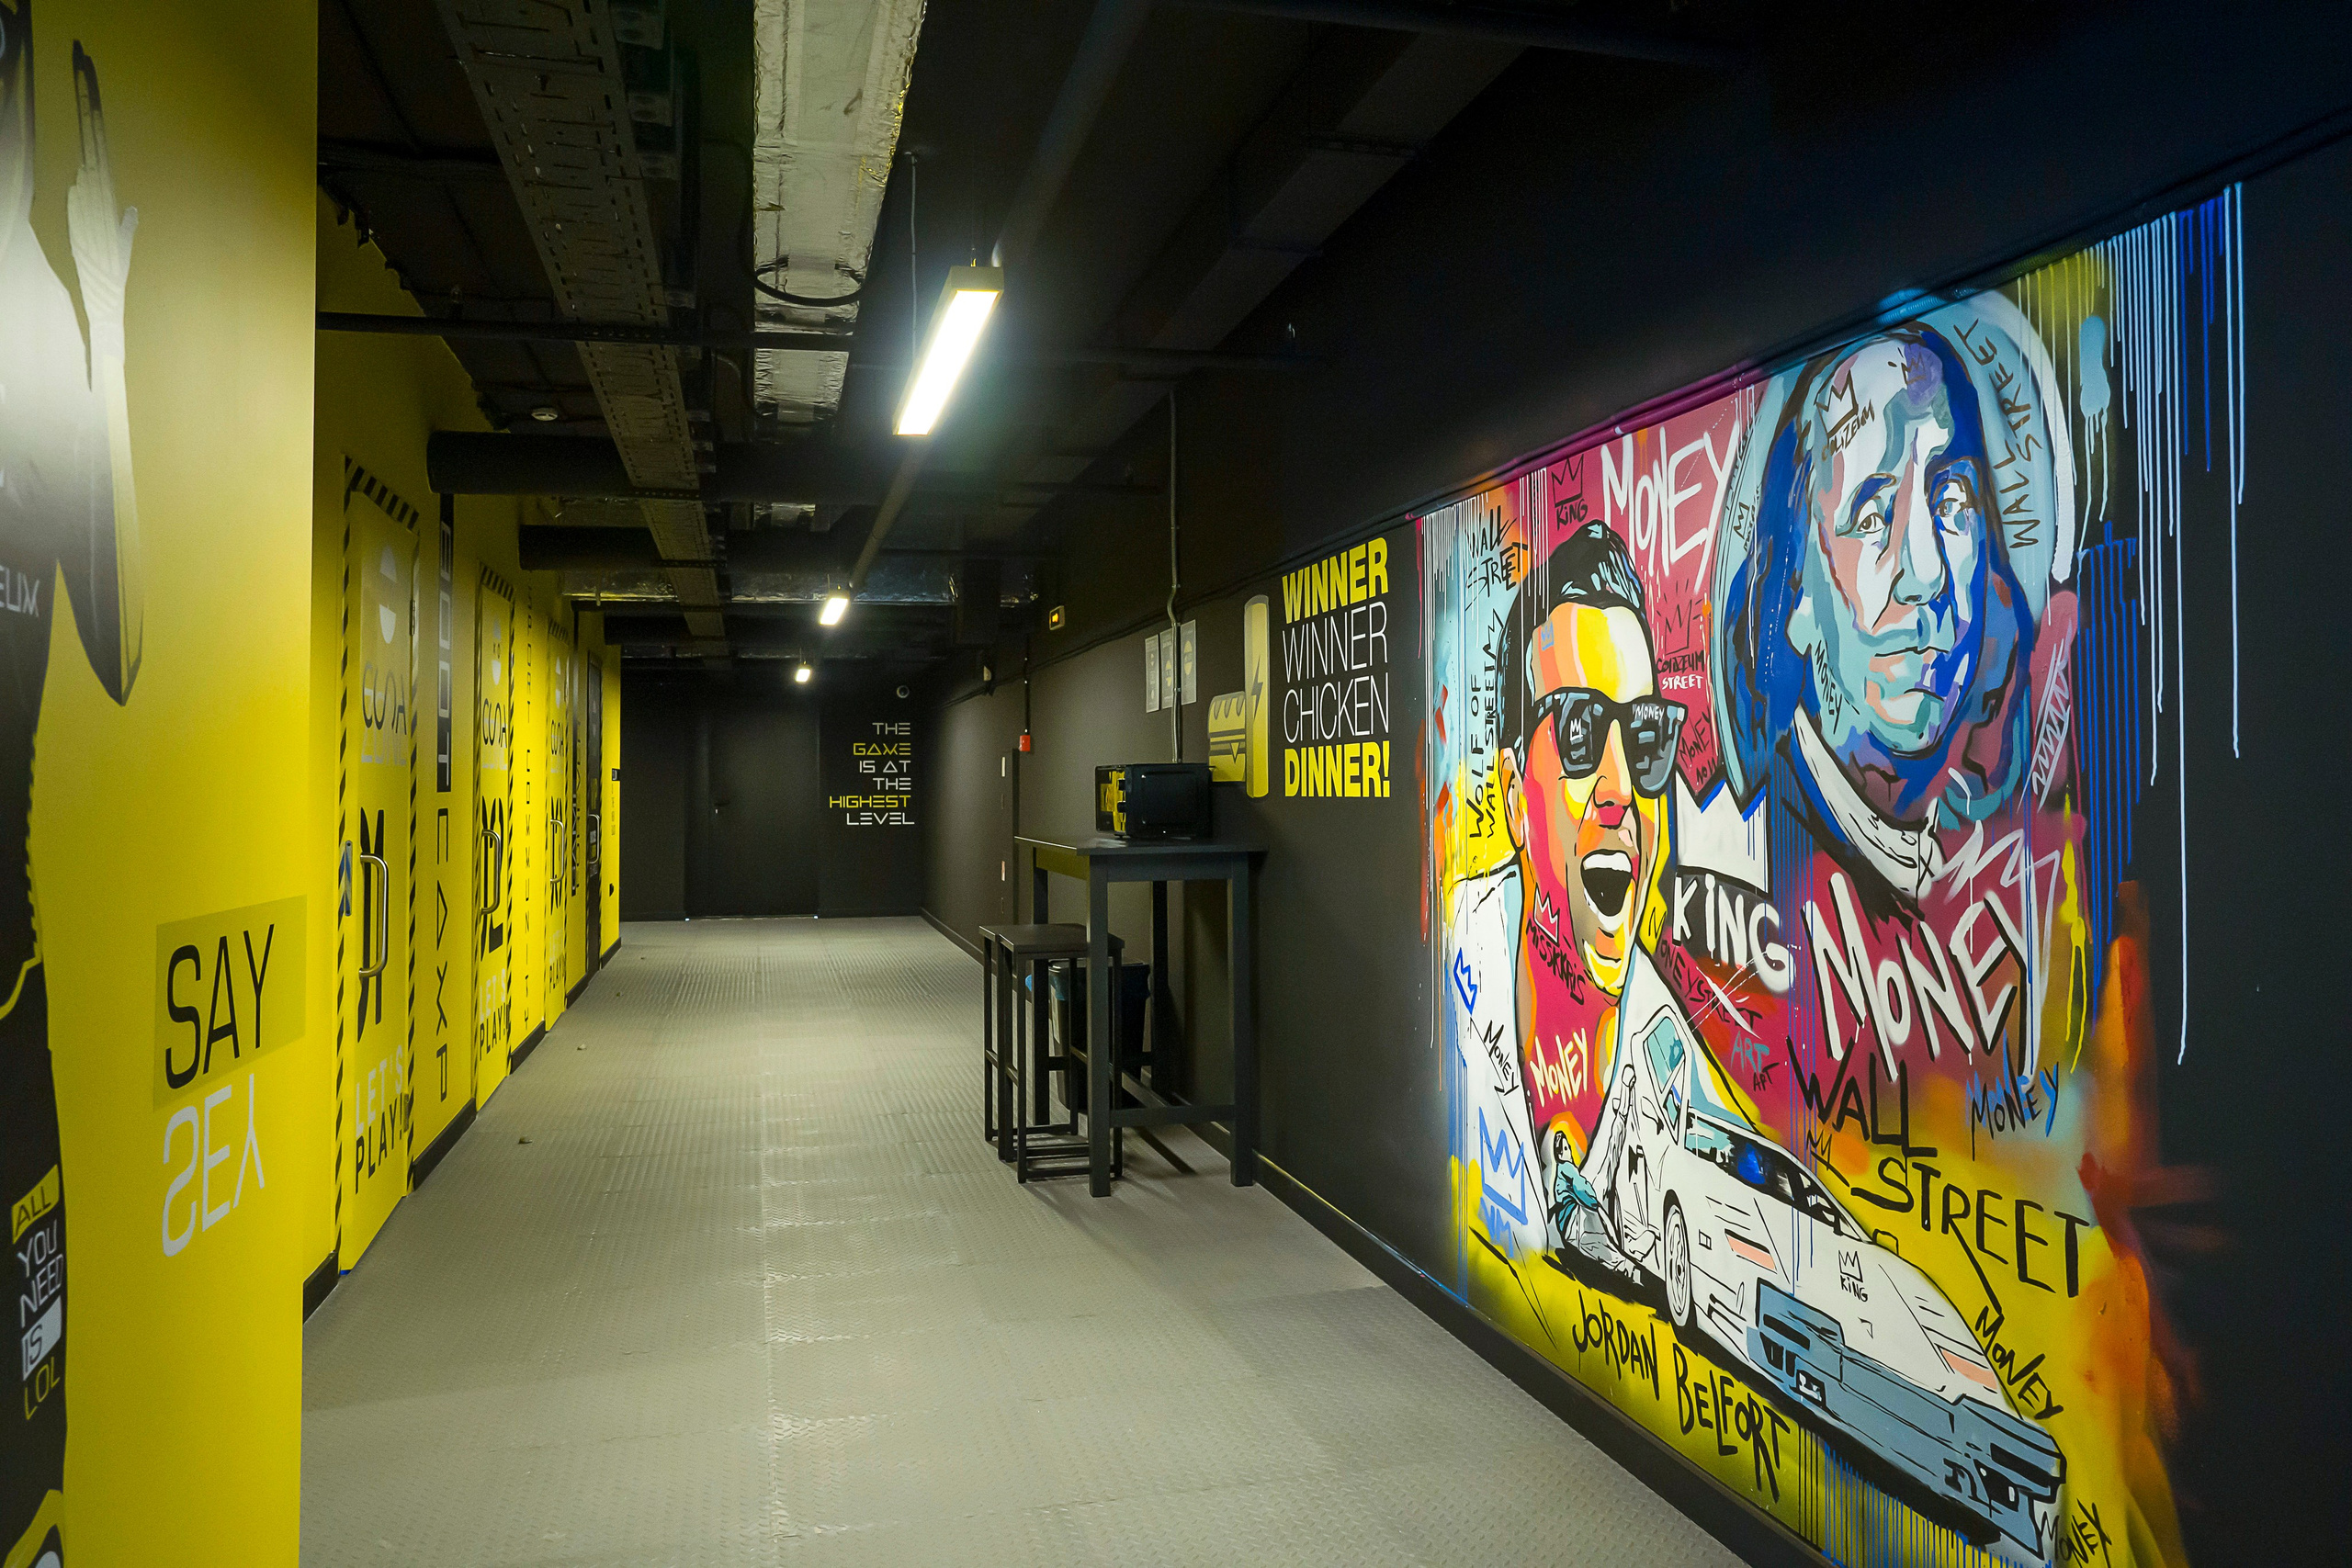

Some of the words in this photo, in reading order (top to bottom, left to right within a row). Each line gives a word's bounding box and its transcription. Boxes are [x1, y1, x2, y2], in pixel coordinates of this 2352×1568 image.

[1953, 318, 2043, 463] STREET
[1600, 419, 1739, 595] MONEY
[1994, 439, 2041, 550] WALL
[1465, 505, 1517, 558] WALL
[1282, 536, 1389, 625] WINNER
[1465, 542, 1529, 611] STREET
[1282, 601, 1388, 683] WINNER
[1283, 671, 1389, 744] CHICKEN
[1470, 673, 1482, 717] OF
[1483, 660, 1497, 749] STREET
[1634, 704, 1664, 722] MONEY
[1662, 674, 1703, 690] STREET
[1815, 640, 1844, 734] MONEY
[854, 742, 911, 756] GAME
[872, 722, 910, 735] THE
[1679, 705, 1714, 768] MONEY
[829, 795, 911, 808] HIGHEST
[860, 760, 876, 773] IS
[882, 760, 911, 773] AT
[873, 777, 911, 791] THE
[1284, 740, 1391, 798] DINNER!
[1465, 733, 1485, 839] WOLF
[1484, 755, 1497, 839] WALL
[846, 812, 915, 826] LEVEL
[164, 923, 276, 1091] SAY
[480, 968, 506, 1022] LET'S
[1801, 872, 2043, 1084] MONEY
[480, 1002, 506, 1062] PLAY!
[1483, 1021, 1521, 1096] MONEY
[1529, 1026, 1589, 1108] MONEY
[1731, 1031, 1776, 1076] ART
[356, 1044, 403, 1137] LET'S
[1753, 1062, 1780, 1092] ART
[1787, 1036, 1938, 1157] WALL
[1966, 1030, 2059, 1161] MONEY
[356, 1092, 403, 1195] PLAY!
[15, 1185, 52, 1236] ALL
[1851, 1157, 2090, 1315] STREET
[17, 1219, 59, 1279] YOU
[20, 1253, 65, 1328] NEED
[25, 1325, 43, 1373] IS
[1975, 1305, 2064, 1420] MONEY
[24, 1357, 61, 1421] LOL
[1572, 1289, 1660, 1401] JORDAN
[1673, 1342, 1791, 1504] BELFORT
[2041, 1498, 2112, 1568] MONEY
